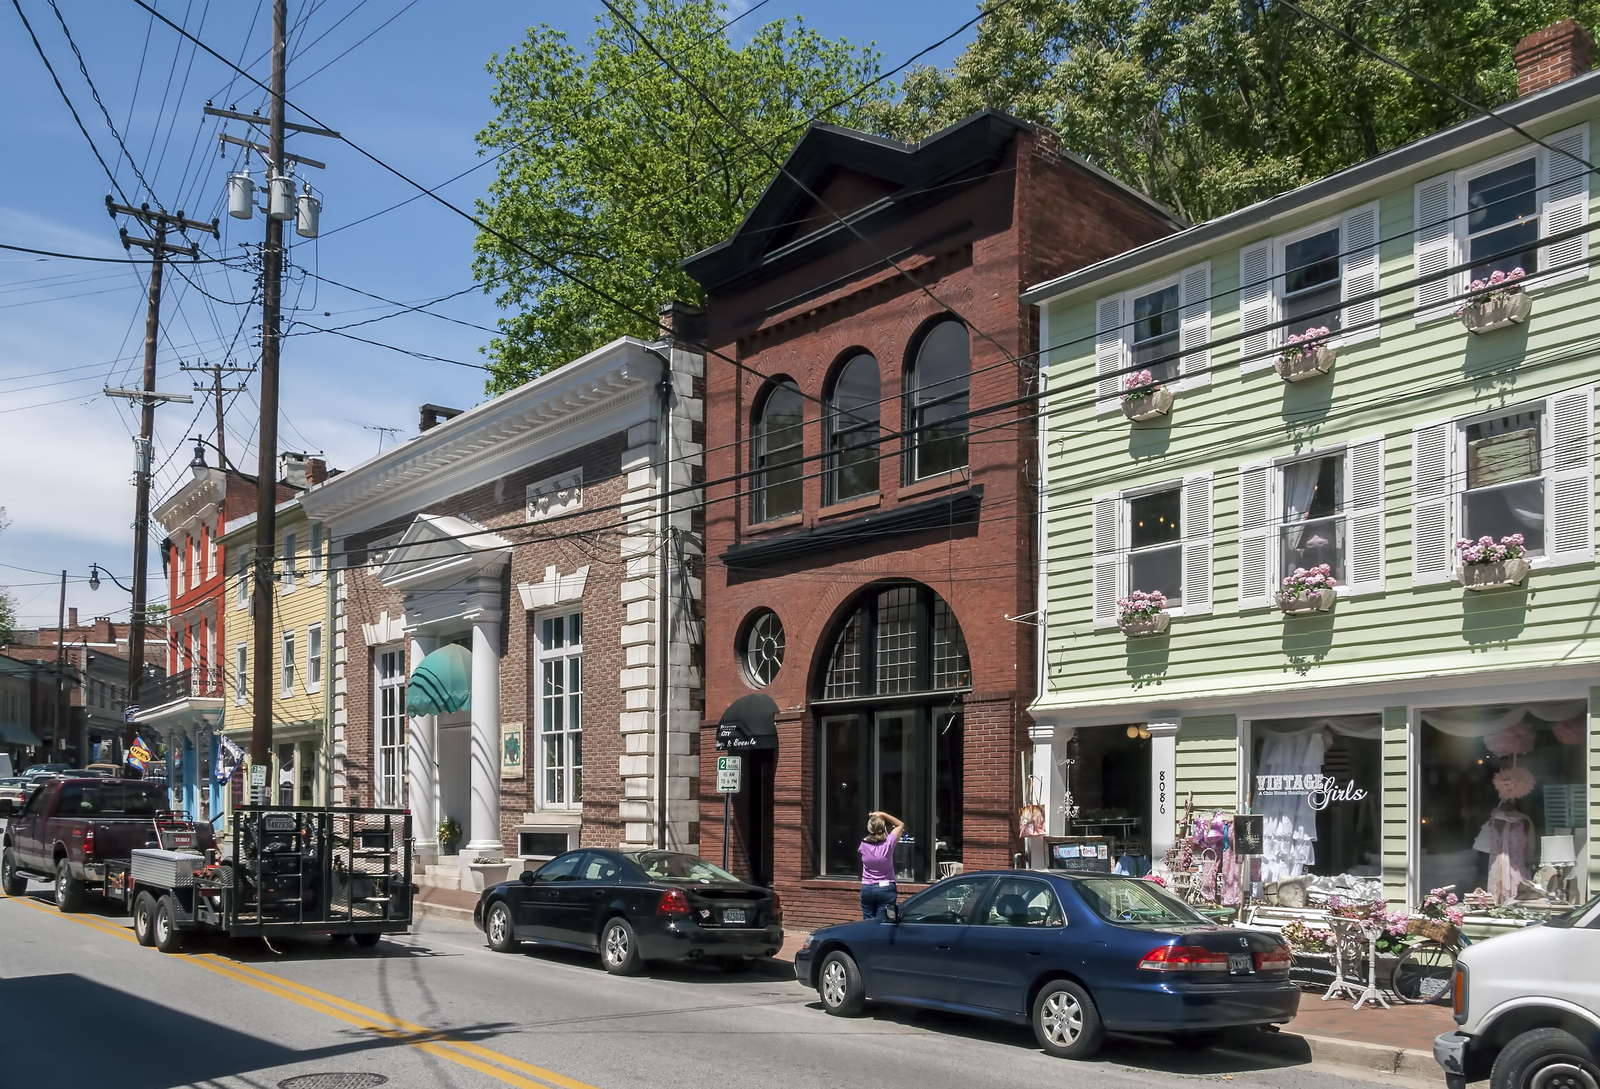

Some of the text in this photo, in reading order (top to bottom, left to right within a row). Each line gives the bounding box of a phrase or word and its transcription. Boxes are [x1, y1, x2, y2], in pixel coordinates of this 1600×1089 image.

[733, 738, 756, 746] Events
[131, 747, 150, 761] OPEN
[720, 759, 725, 769] 2
[1256, 774, 1368, 810] VINTAGE Girls
